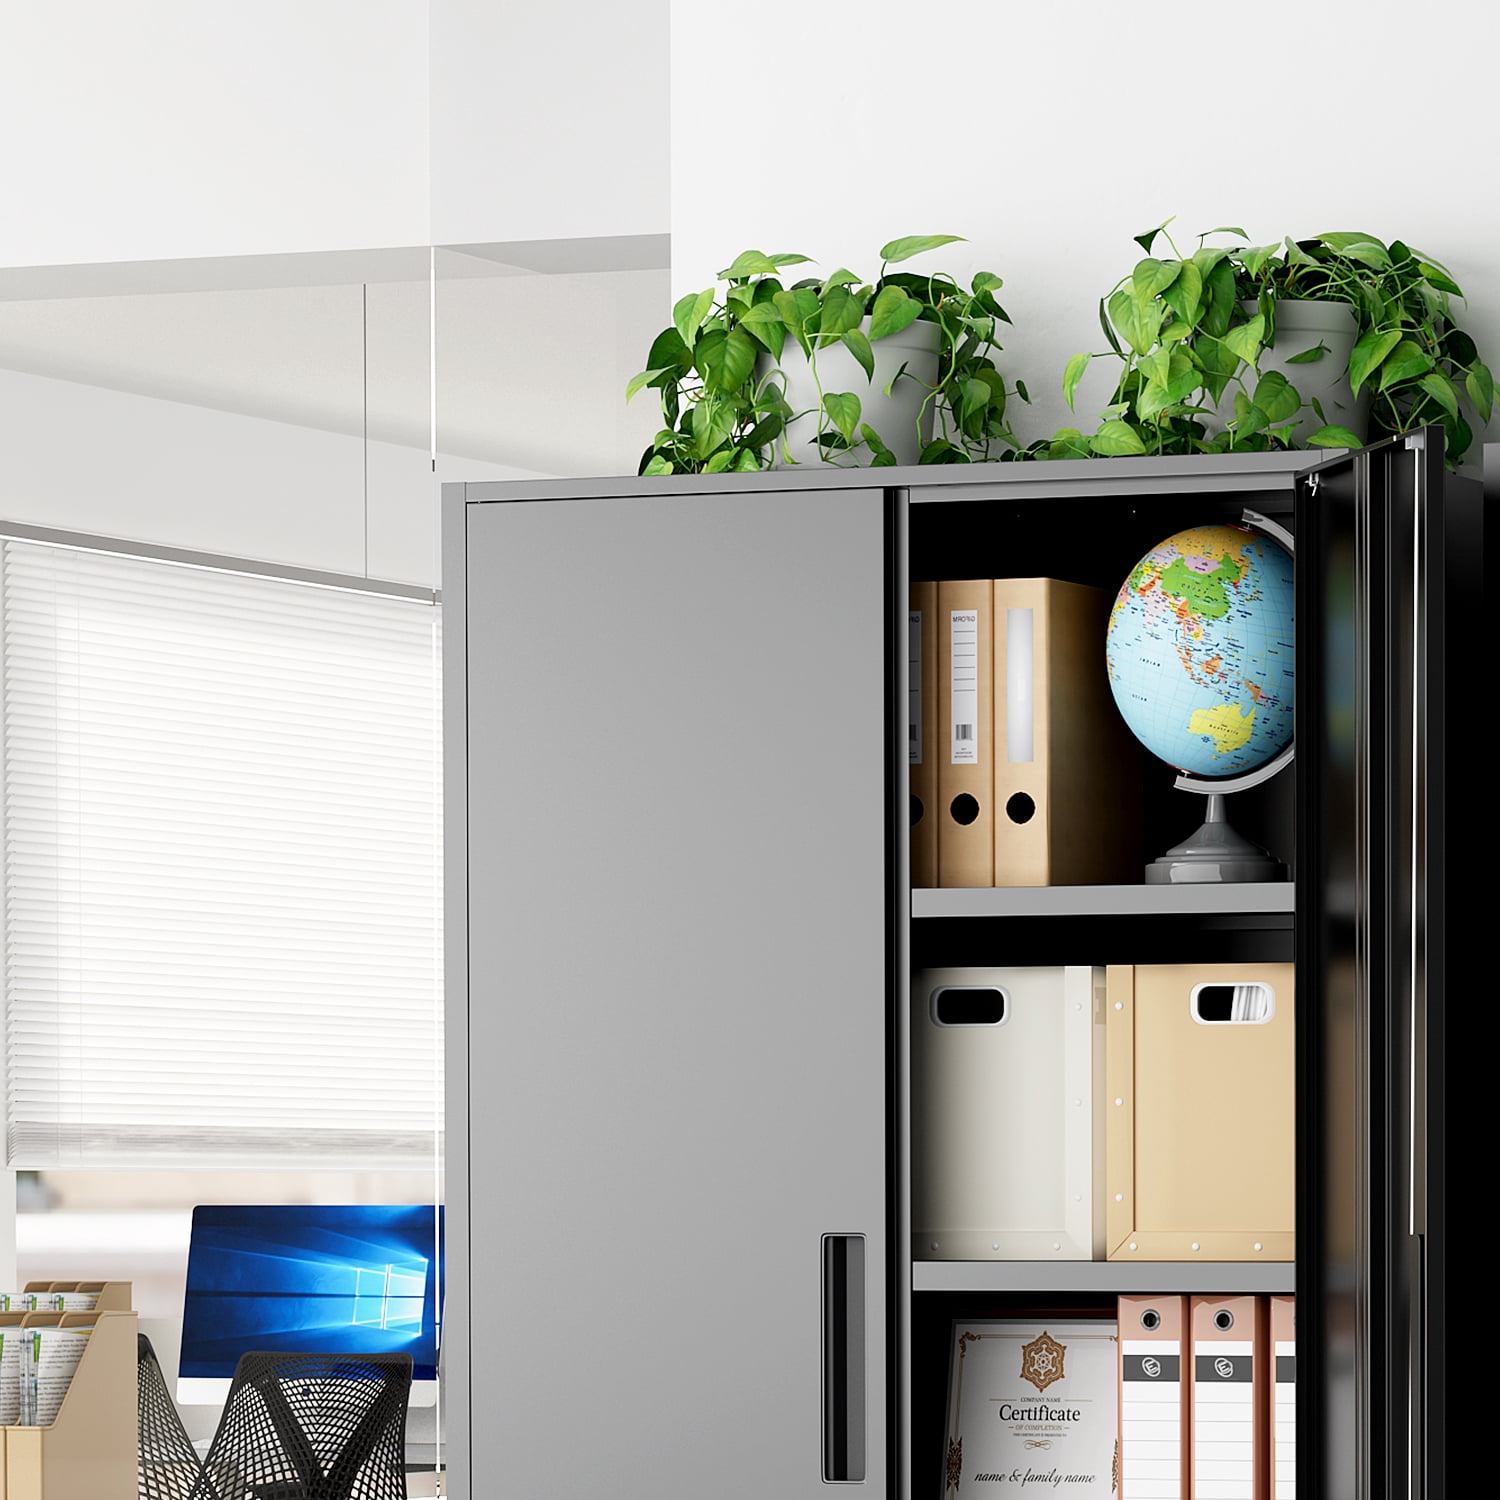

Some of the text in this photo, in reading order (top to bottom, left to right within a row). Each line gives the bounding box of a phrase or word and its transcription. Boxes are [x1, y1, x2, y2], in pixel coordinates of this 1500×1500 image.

[999, 1404, 1081, 1421] Certificate
[974, 1467, 1096, 1488] name & family name
